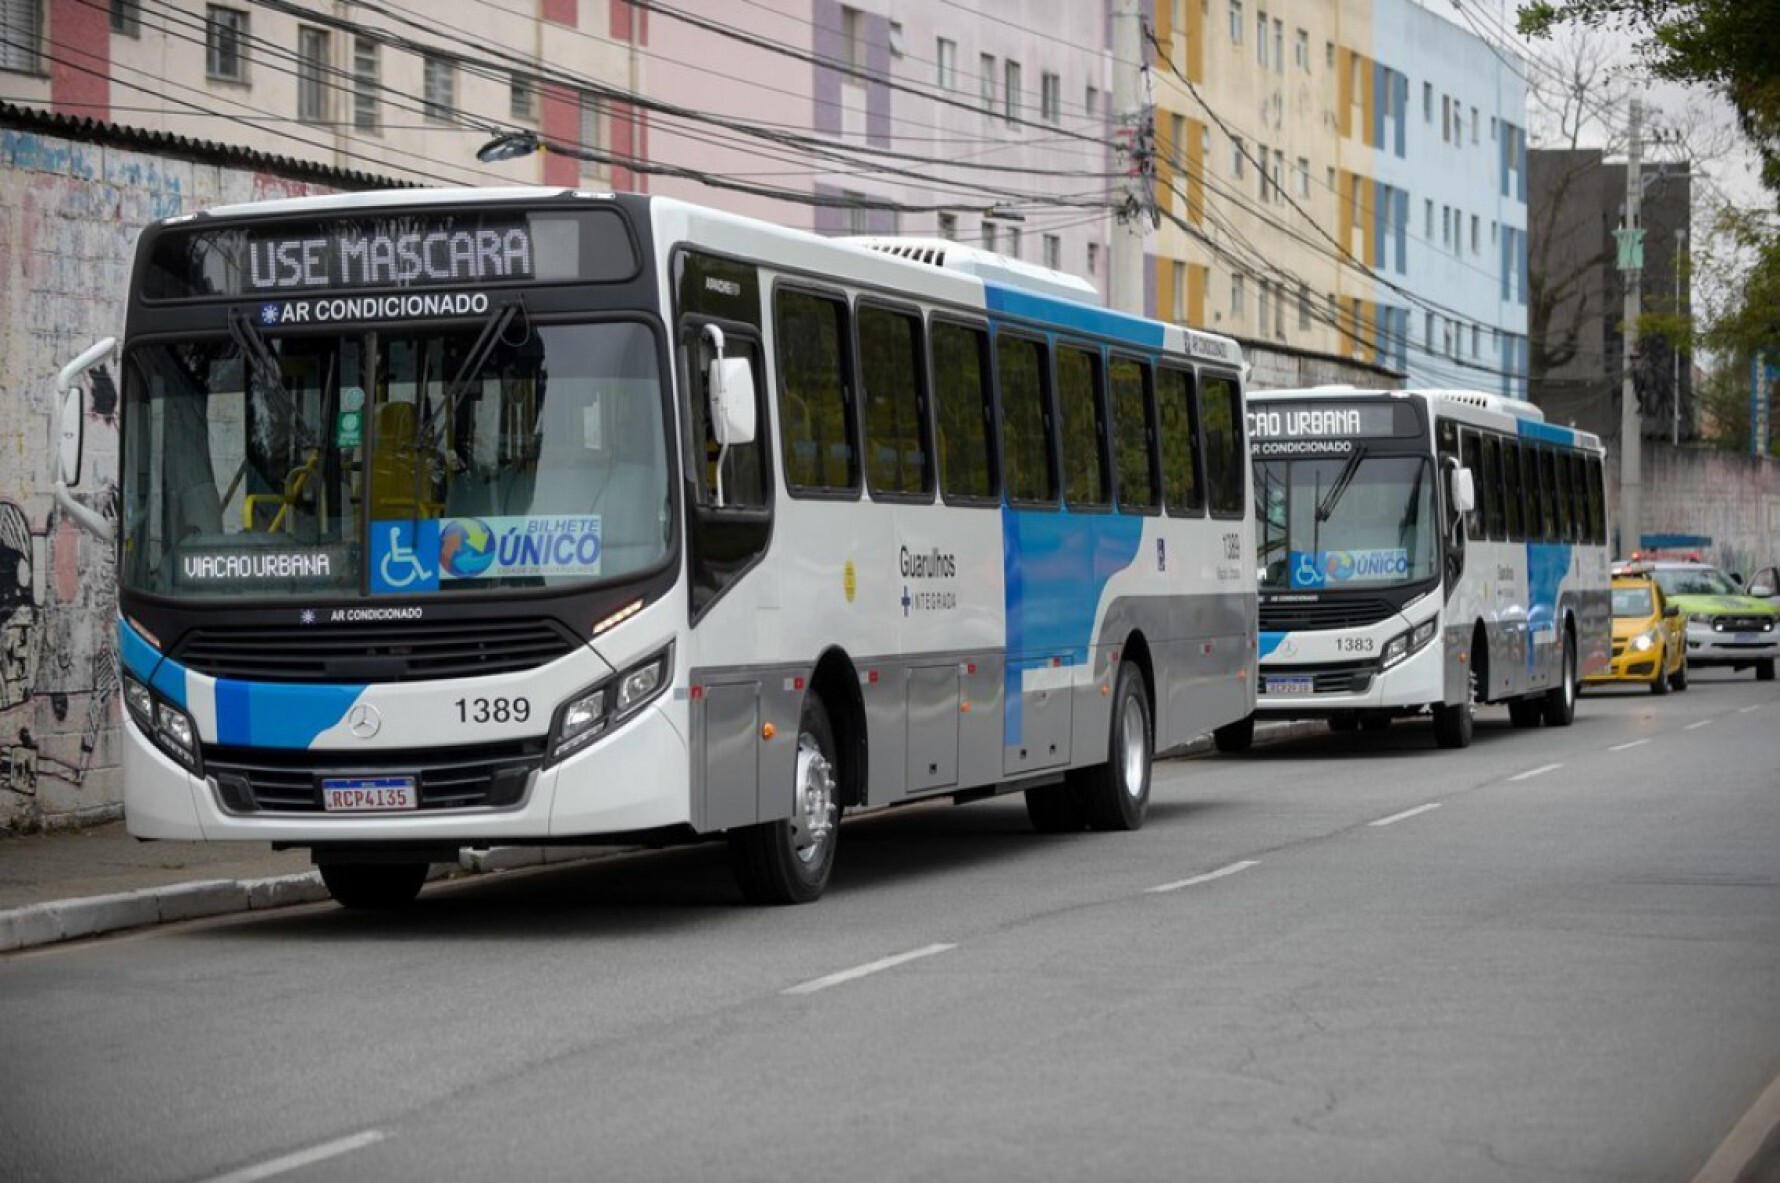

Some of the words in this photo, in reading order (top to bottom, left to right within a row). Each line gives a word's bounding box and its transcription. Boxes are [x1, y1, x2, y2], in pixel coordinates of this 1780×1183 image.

[250, 239, 329, 287] USE
[340, 229, 530, 284] MASCARA
[280, 302, 310, 322] AR
[314, 293, 489, 321] CONDICIONADO
[1286, 409, 1361, 435] URBANA
[1262, 440, 1352, 454] CONDICIONADO
[527, 519, 600, 533] BILHETE
[498, 527, 600, 566] ÚNICO
[900, 545, 956, 578] Guarulhos
[330, 609, 345, 620] AR
[347, 606, 423, 620] CONDICIONADO
[1335, 637, 1375, 652] 1383
[455, 697, 531, 723] 1389
[332, 789, 407, 807] RCP4135
